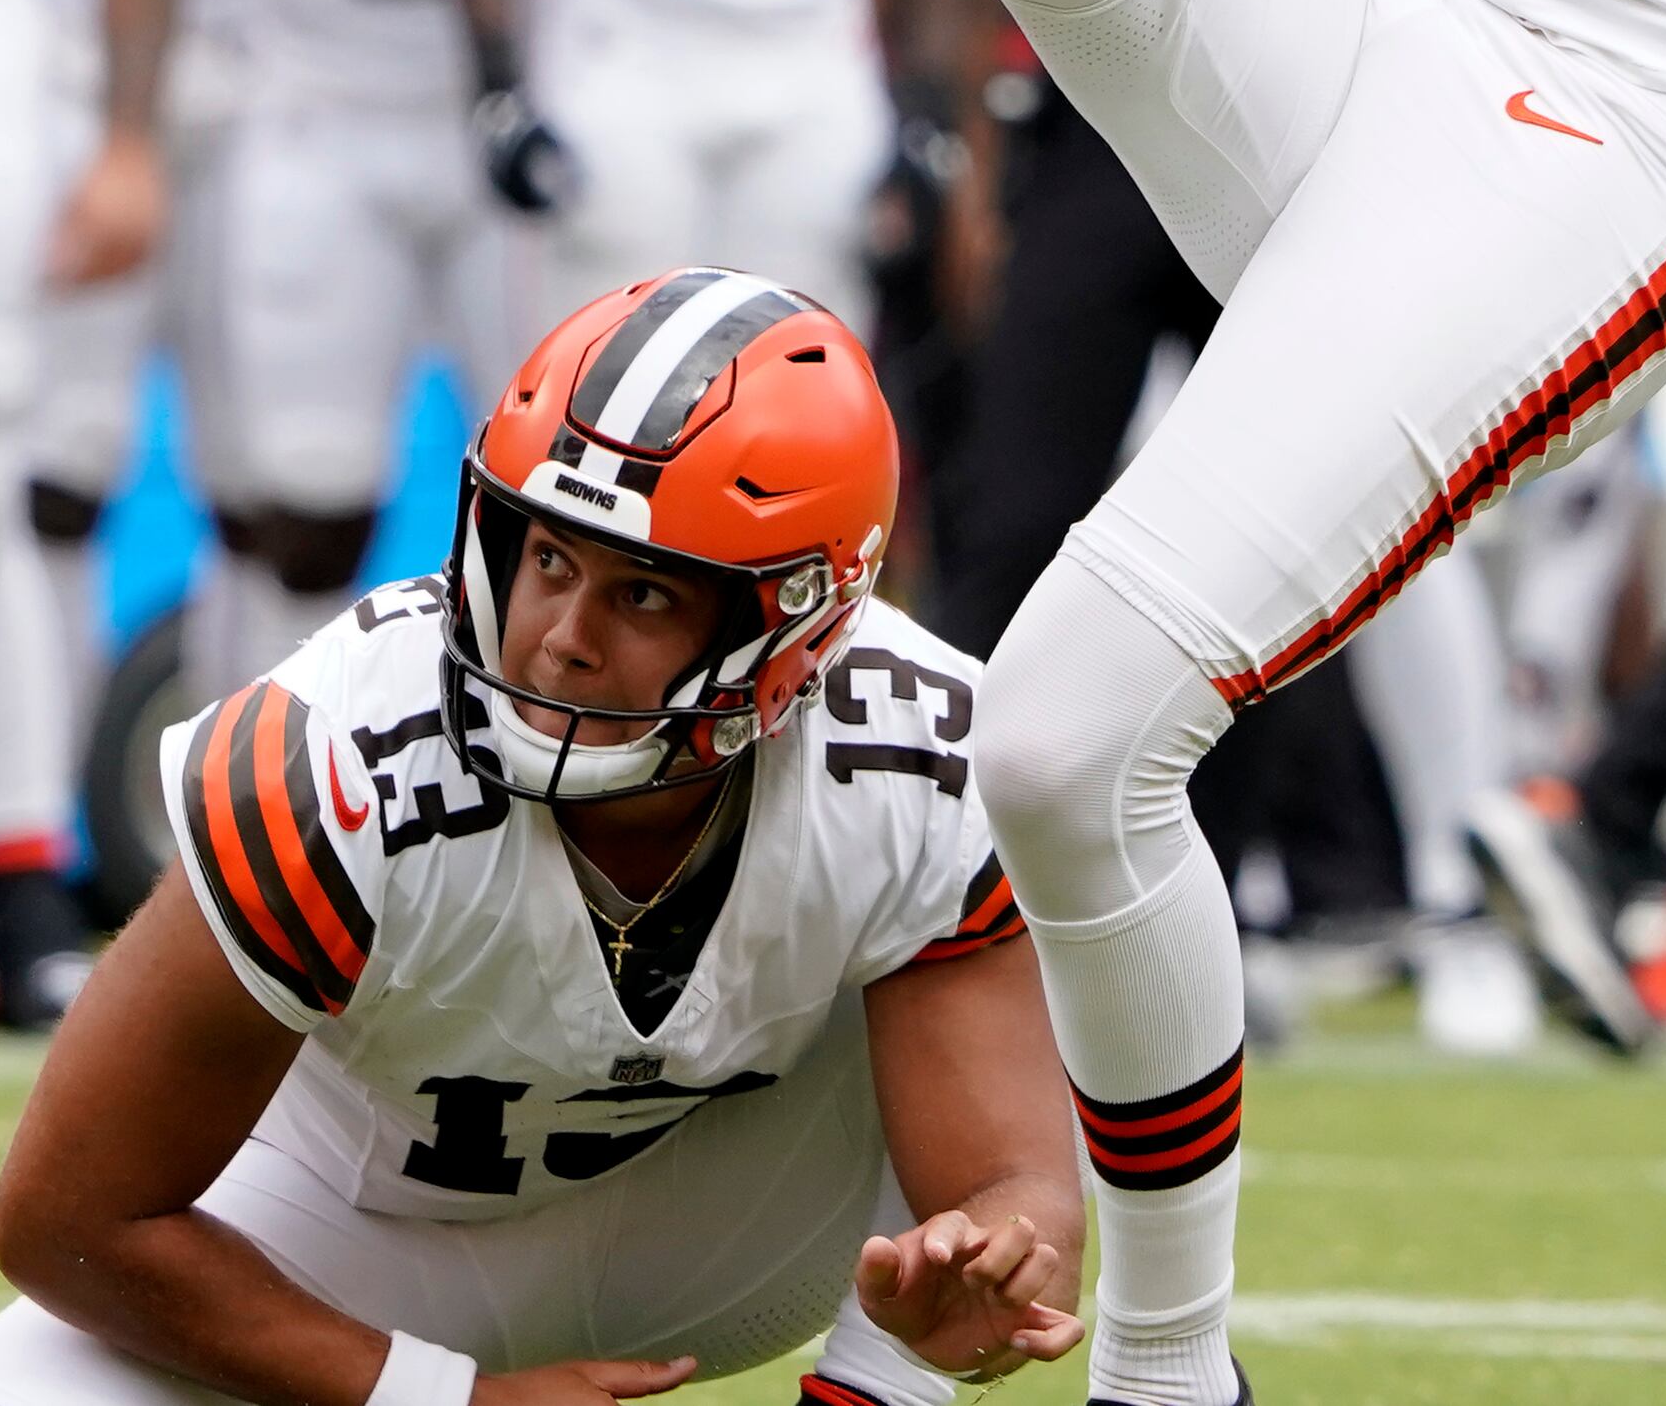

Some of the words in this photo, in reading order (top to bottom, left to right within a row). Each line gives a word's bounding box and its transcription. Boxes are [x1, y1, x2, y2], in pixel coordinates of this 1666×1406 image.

[555, 473, 618, 511] BROWNS
[351, 688, 511, 857] 13
[825, 646, 974, 800] 13
